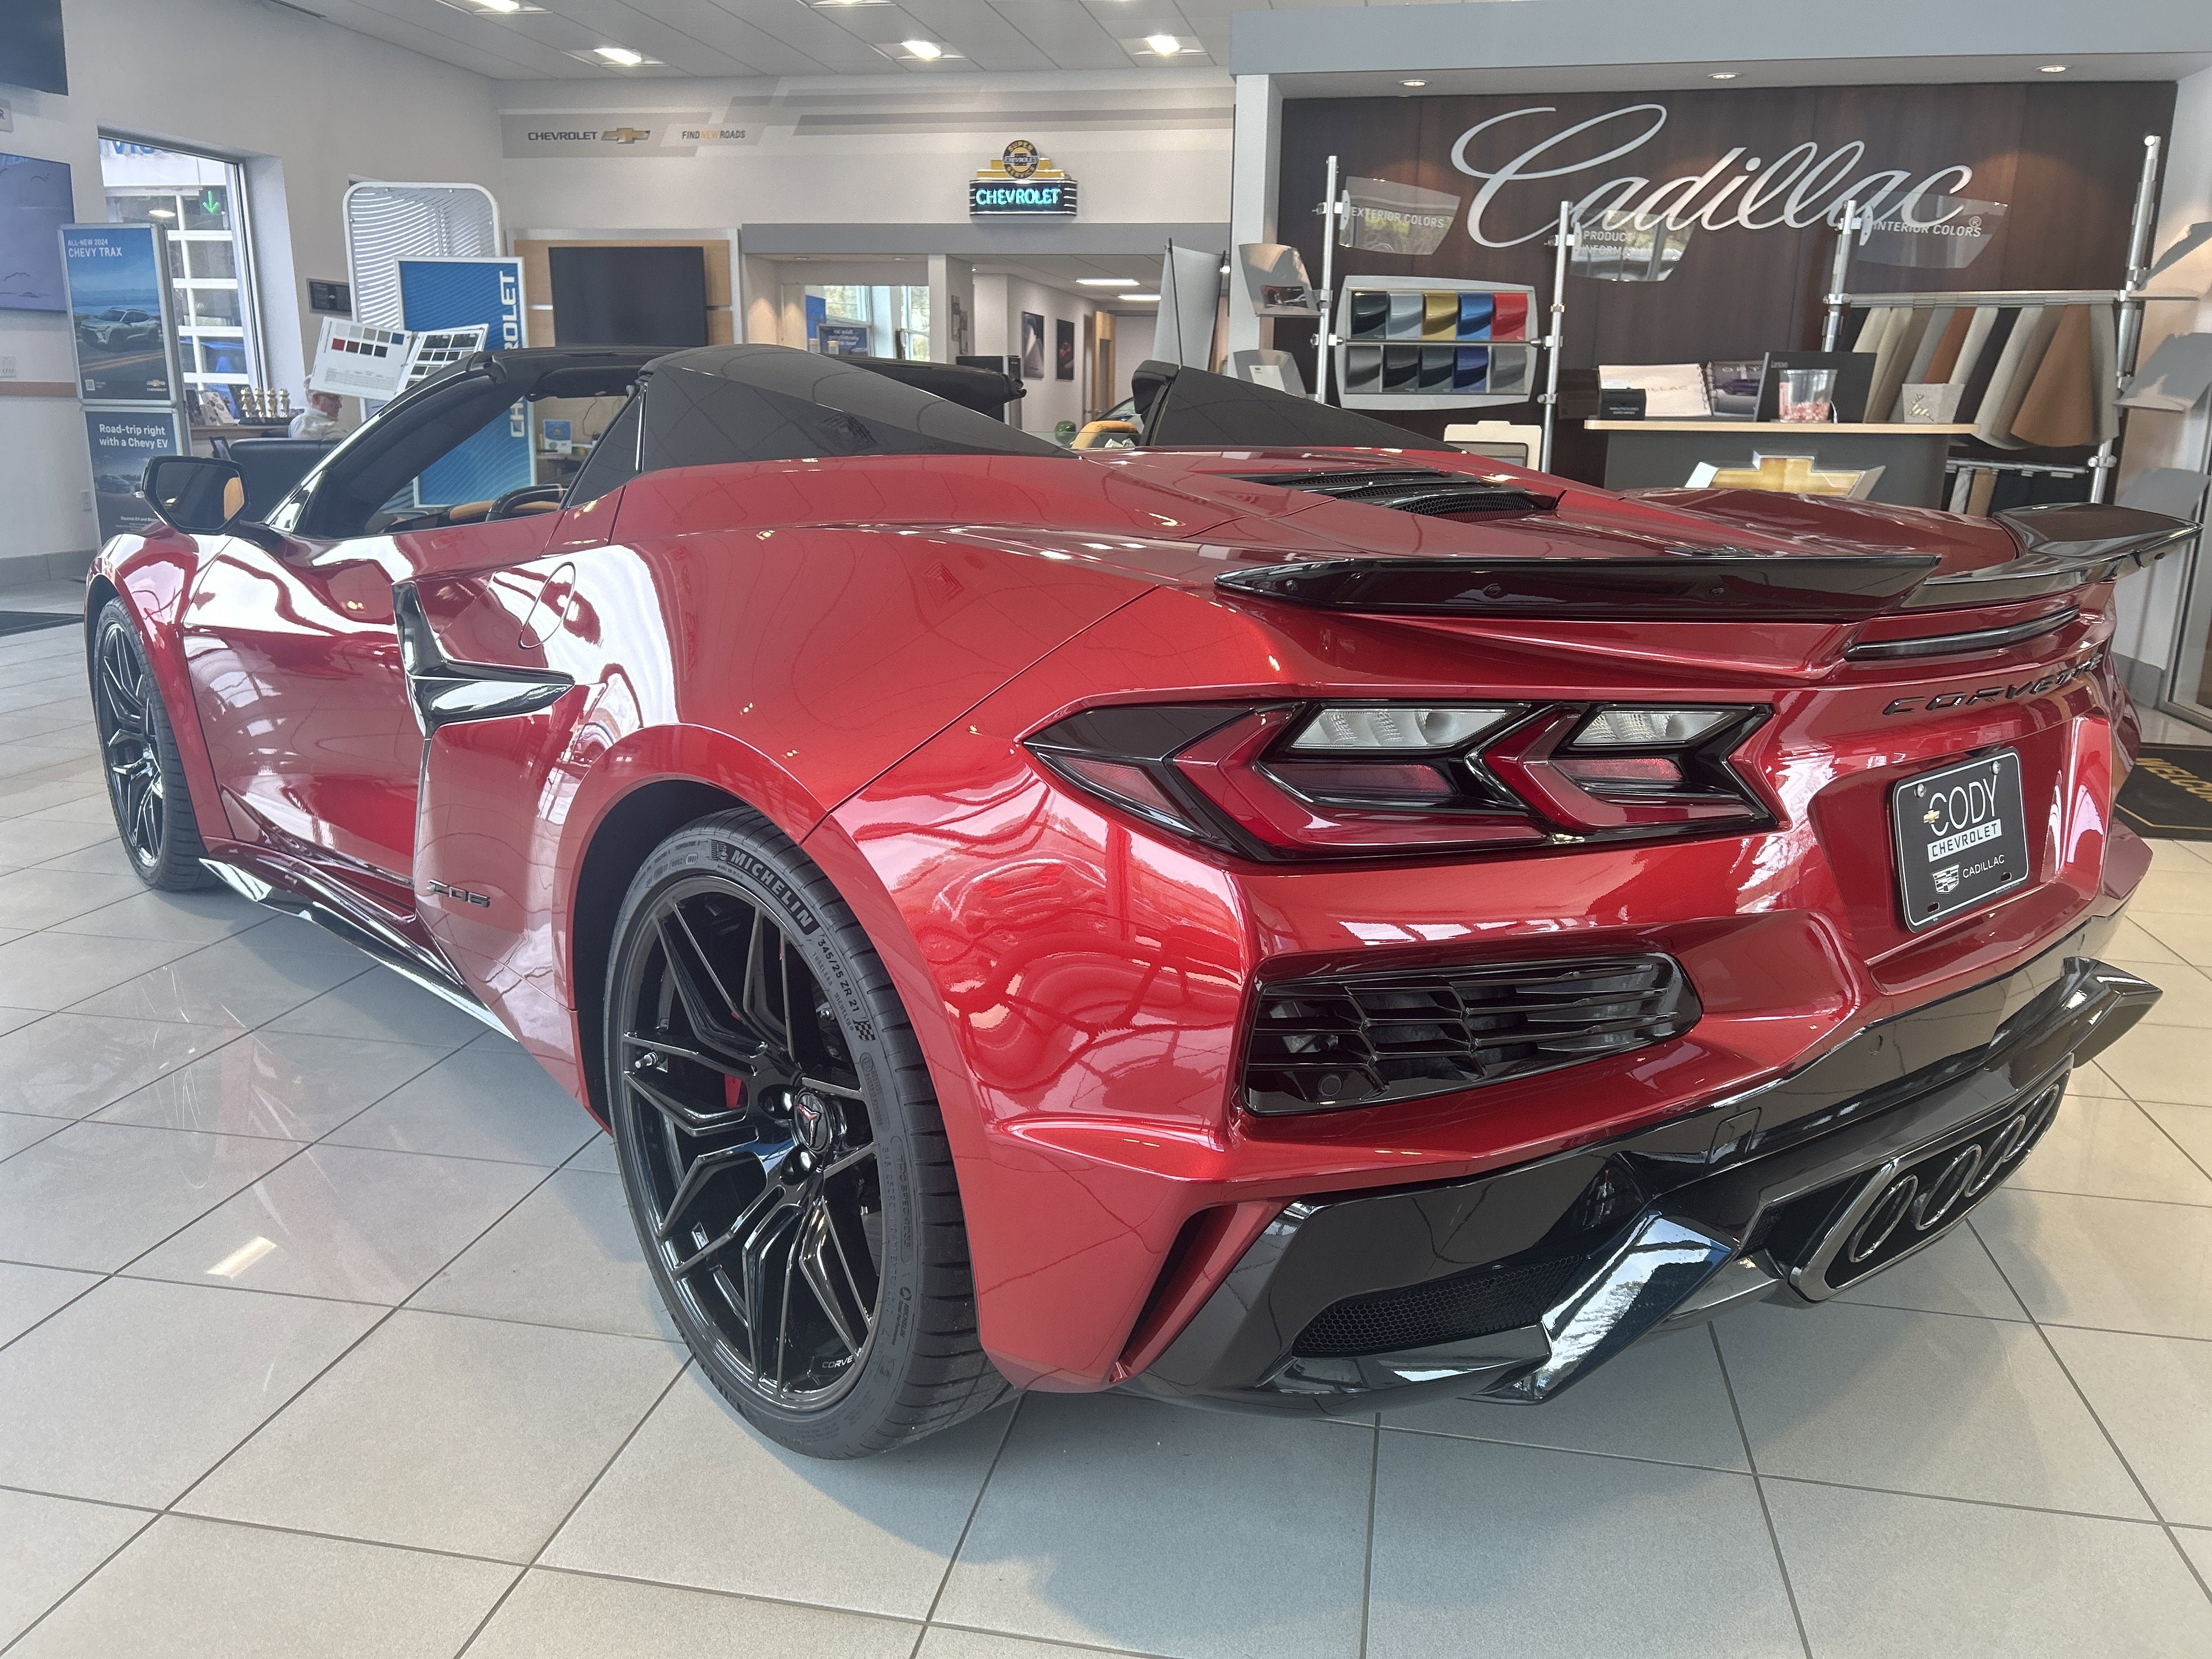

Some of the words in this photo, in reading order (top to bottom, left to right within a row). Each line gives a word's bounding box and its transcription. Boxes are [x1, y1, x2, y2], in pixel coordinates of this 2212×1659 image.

[528, 131, 598, 141] CHEVROLET
[681, 131, 701, 139] FIND
[719, 130, 746, 139] ROADS
[1451, 104, 1972, 247] Cadillac
[975, 187, 1062, 205] CHEVROLET
[1351, 206, 1401, 222] EXTERIOR
[1403, 213, 1444, 228] COLORS
[1583, 230, 1634, 242] PRODUCT
[1873, 221, 1929, 234] INTERIOR
[1932, 224, 1982, 238] COLORS
[68, 247, 97, 257] CHEVY
[99, 246, 122, 257] TRAX
[99, 423, 142, 436] Road-trip
[144, 425, 166, 437] right
[99, 436, 119, 447] with
[128, 437, 155, 449] Chevy
[157, 438, 168, 448] EV
[1882, 653, 2103, 715] CORVETTE
[1929, 775, 1997, 837] CODY
[1932, 822, 1997, 858] CHEVROLET
[1962, 854, 2005, 878] CADILLAC
[426, 878, 491, 908] Z06
[730, 850, 814, 928] MICHELIN
[817, 938, 844, 979] 345/25
[840, 979, 853, 997] ZR
[849, 998, 860, 1012] 21
[899, 1303, 910, 1339] MICHELIN
